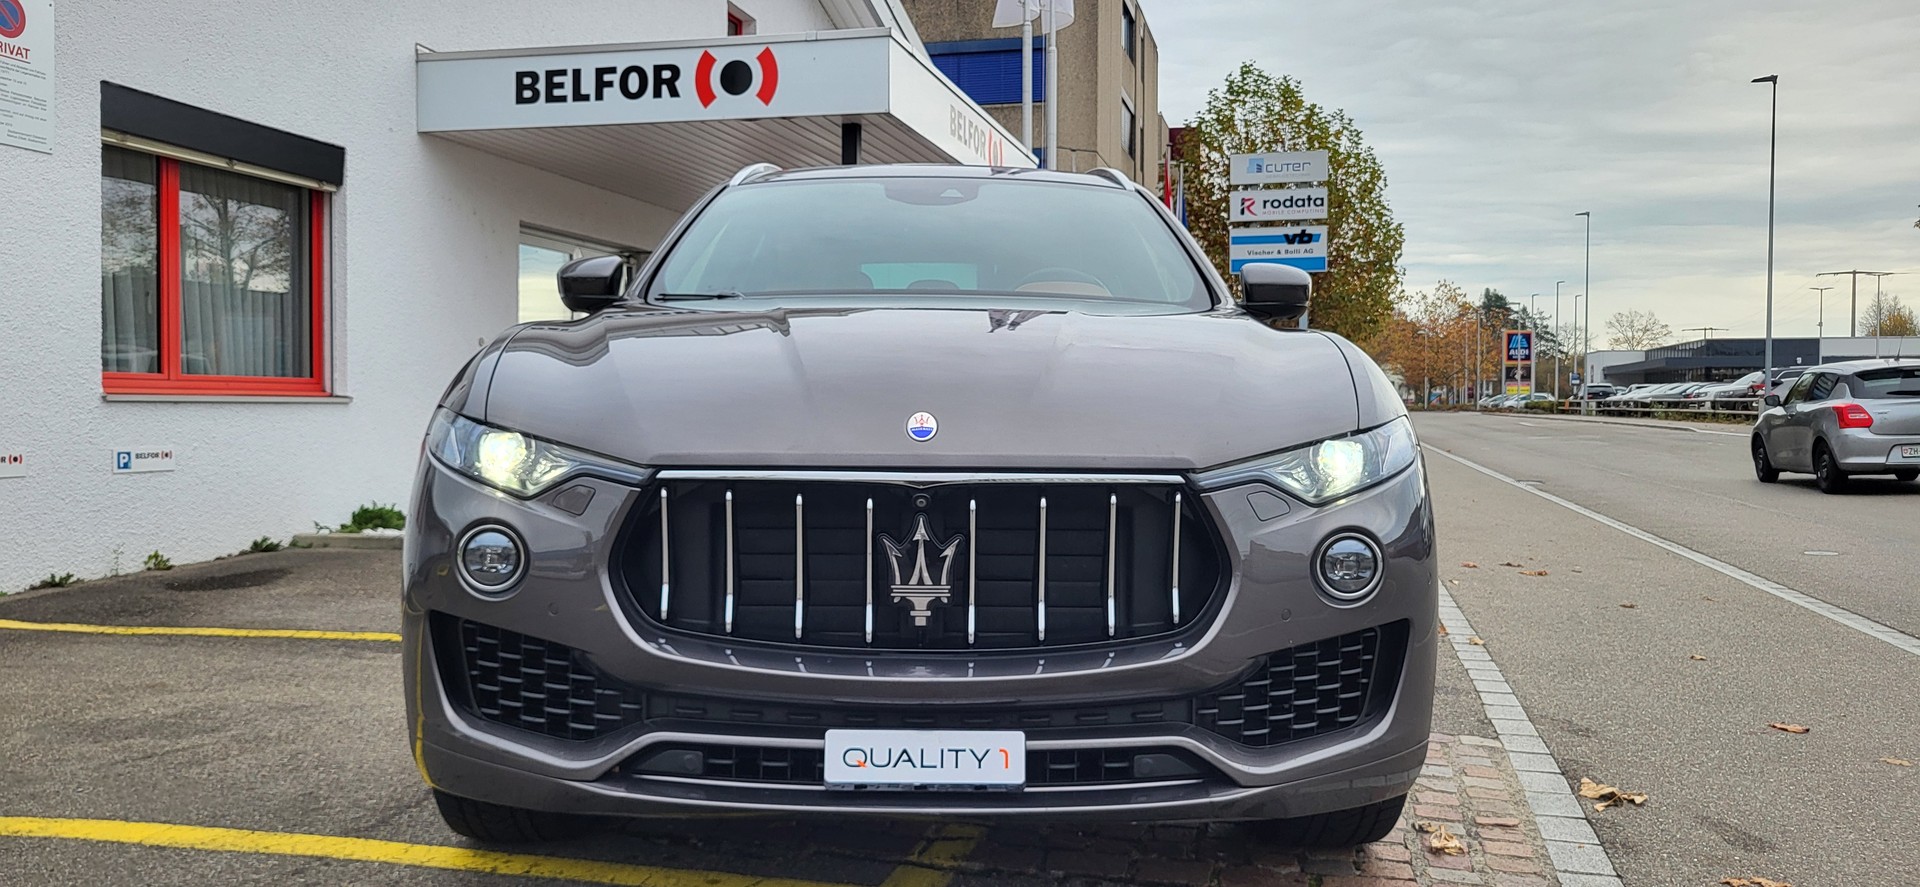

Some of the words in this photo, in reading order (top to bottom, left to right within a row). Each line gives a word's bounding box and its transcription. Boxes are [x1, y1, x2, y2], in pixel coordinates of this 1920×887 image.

[515, 64, 681, 105] BELFOR
[949, 104, 986, 160] BELFOR
[1263, 194, 1325, 209] rodata
[1283, 229, 1314, 245] vb
[119, 453, 130, 468] P
[135, 452, 160, 460] BELFOR
[842, 748, 991, 769] QUALITY
[998, 748, 1009, 769] 1
